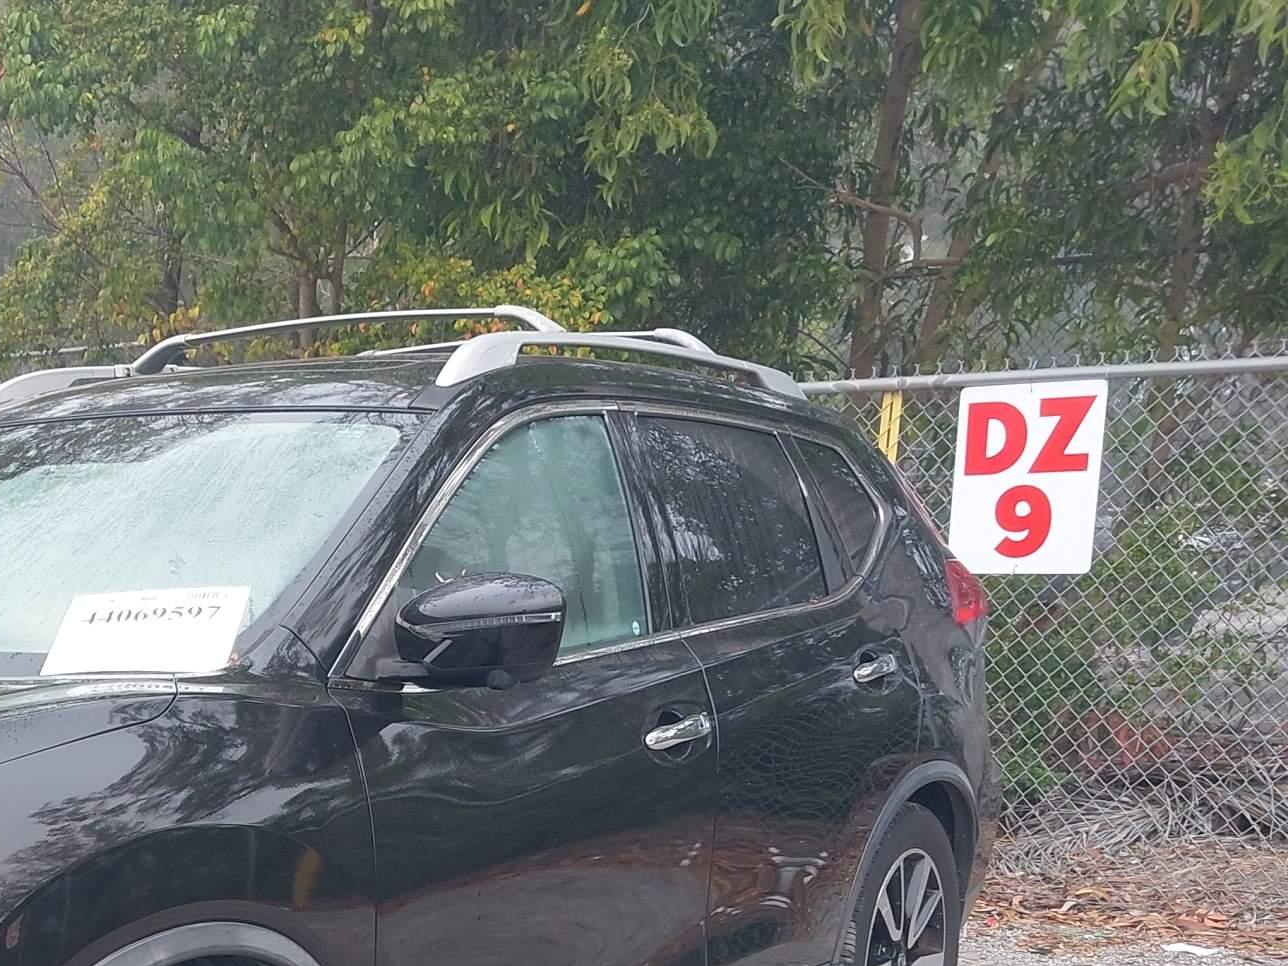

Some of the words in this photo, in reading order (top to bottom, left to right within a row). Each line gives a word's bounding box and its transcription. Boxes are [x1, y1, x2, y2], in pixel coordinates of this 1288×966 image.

[964, 394, 1098, 476] DZ
[993, 484, 1053, 559] 9
[81, 605, 221, 625] 44069597
